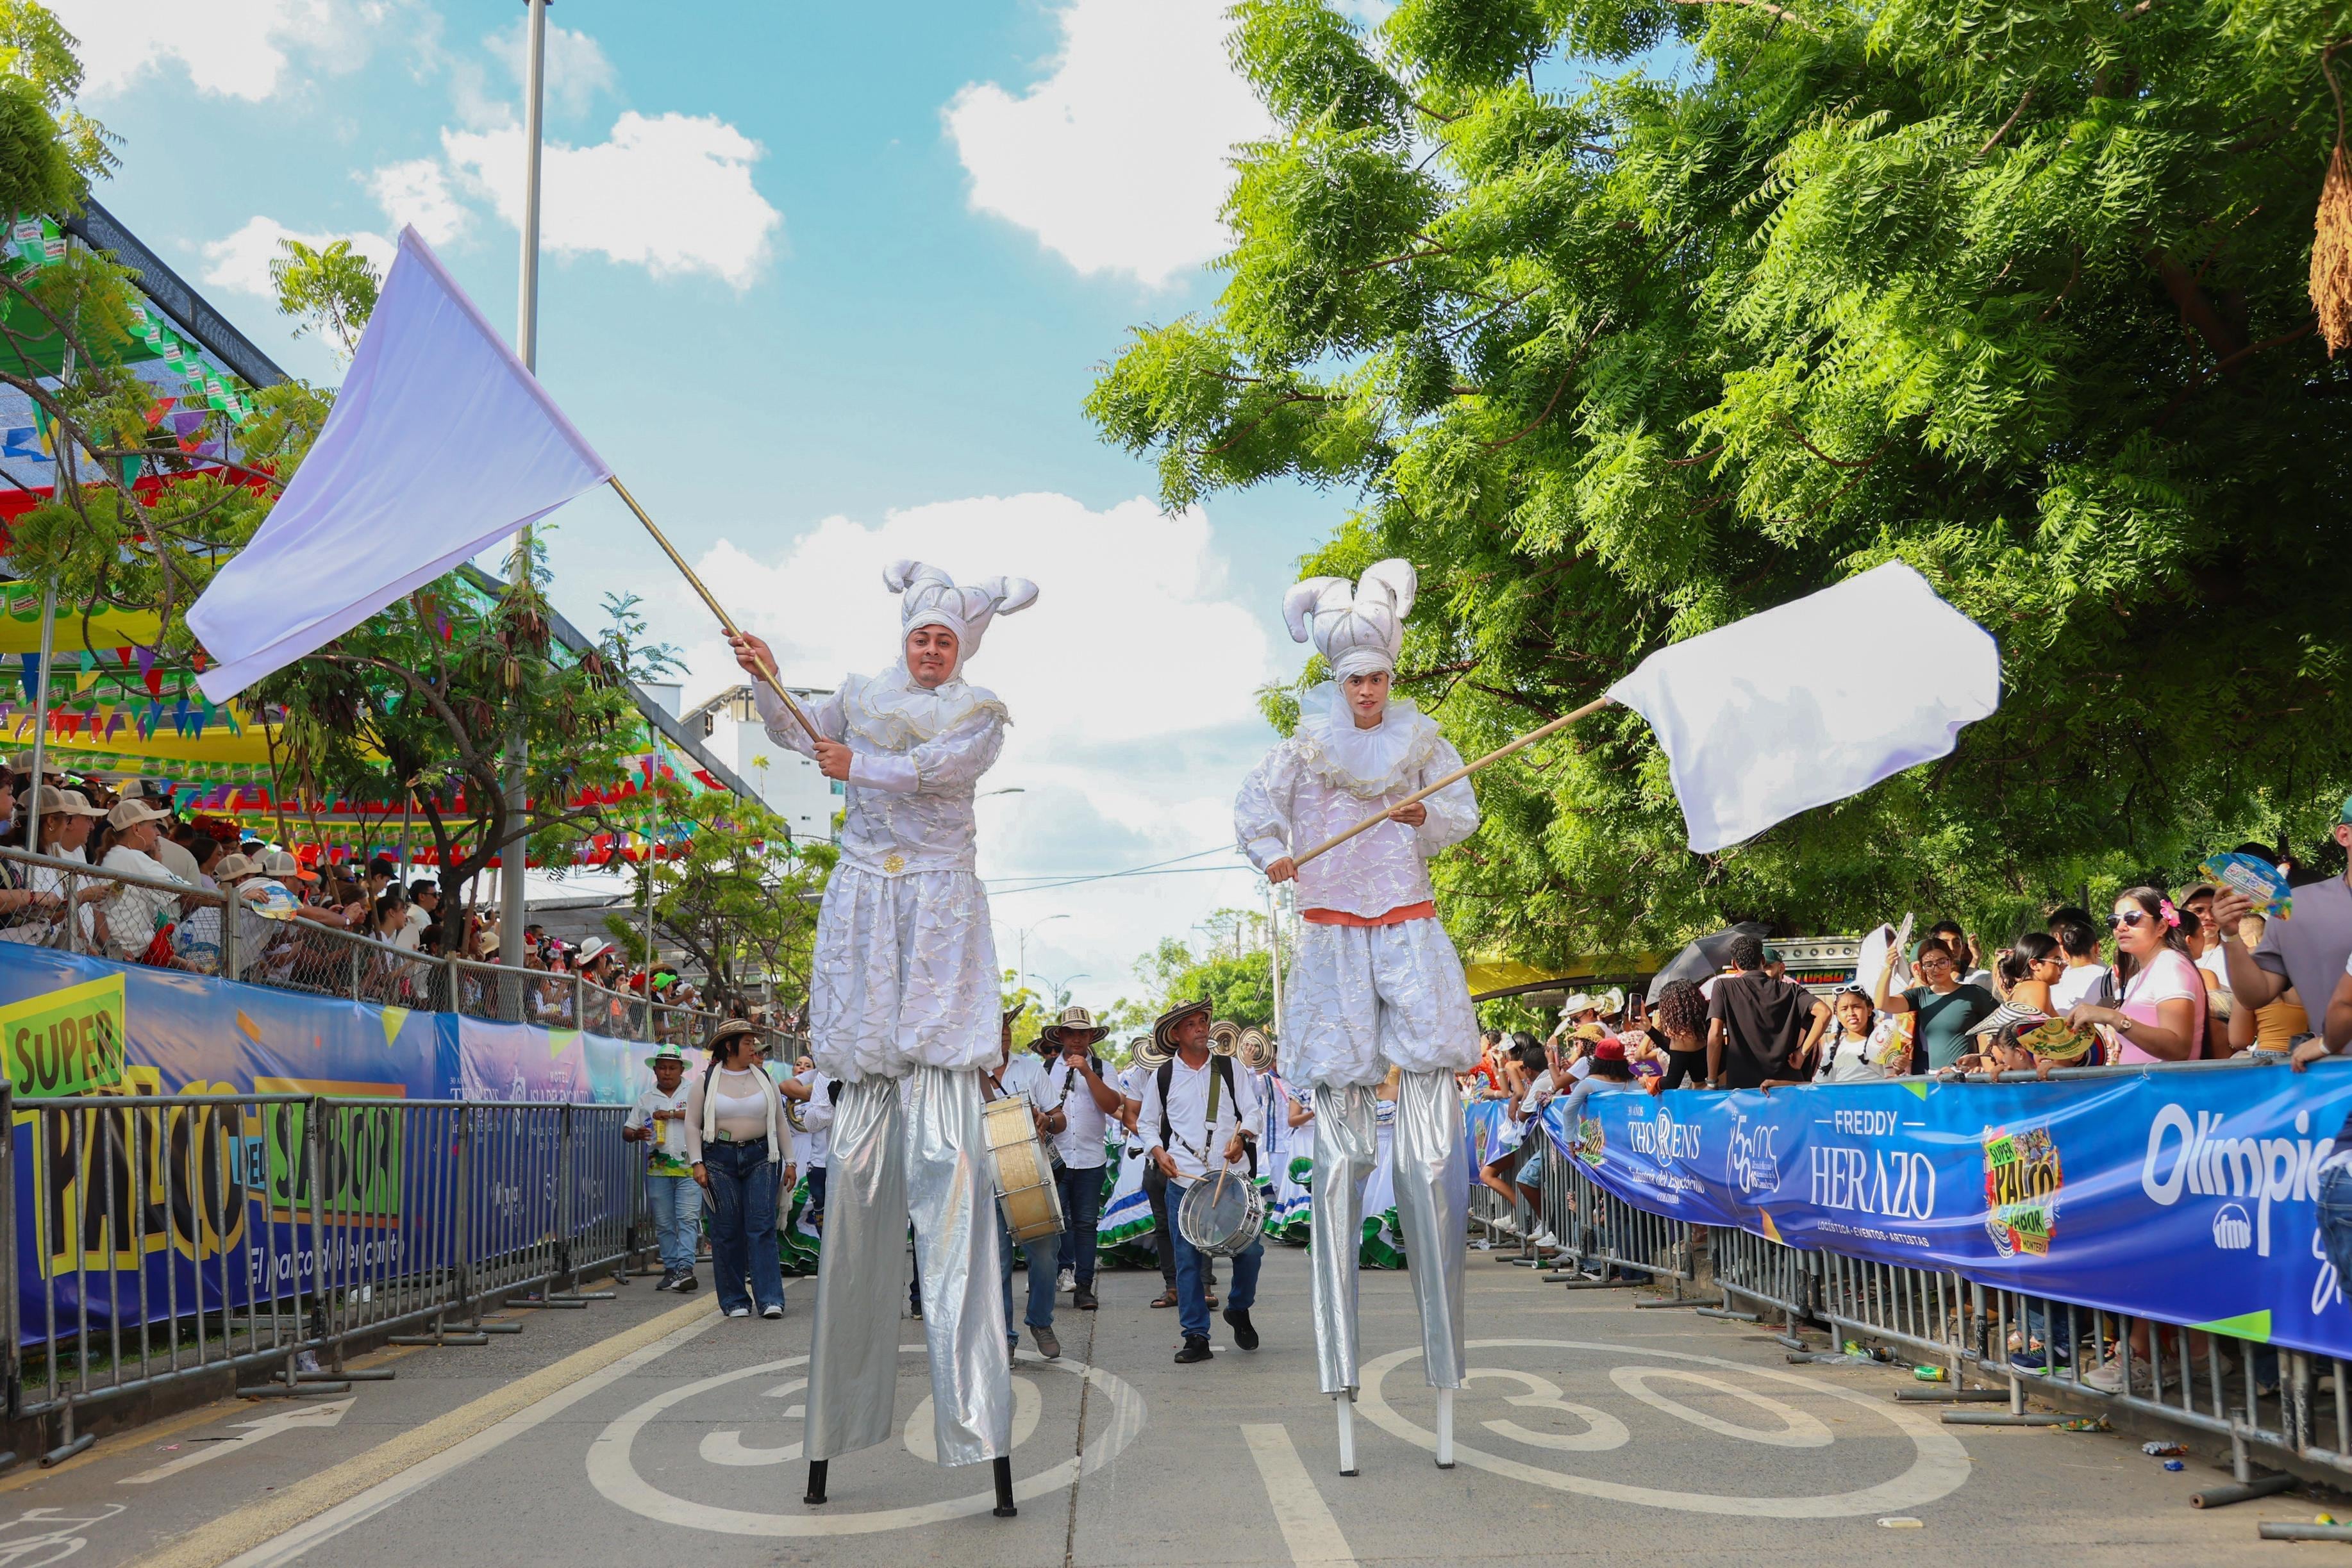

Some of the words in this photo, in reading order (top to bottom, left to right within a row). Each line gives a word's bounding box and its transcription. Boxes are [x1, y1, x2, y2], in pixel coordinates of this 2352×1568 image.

[1796, 970, 1845, 984] TURBO
[15, 1010, 116, 1094] SUPER
[550, 1071, 568, 1083] HOTEL
[1835, 1110, 1897, 1136] FREDDY
[47, 1084, 242, 1255] PALCO
[276, 1101, 390, 1203] SABOR
[1990, 1142, 2015, 1164] SUPER
[1656, 1170, 1667, 1187] del
[1810, 1146, 1936, 1221] HERAZO
[1996, 1158, 2055, 1206] PALCO
[2142, 1103, 2335, 1257] Olímpic
[1853, 1226, 1887, 1242] EVENTOS
[1890, 1233, 1930, 1247] ARTISTAS
[2009, 1206, 2044, 1233] SABOR
[1461, 1366, 1835, 1451] 30
